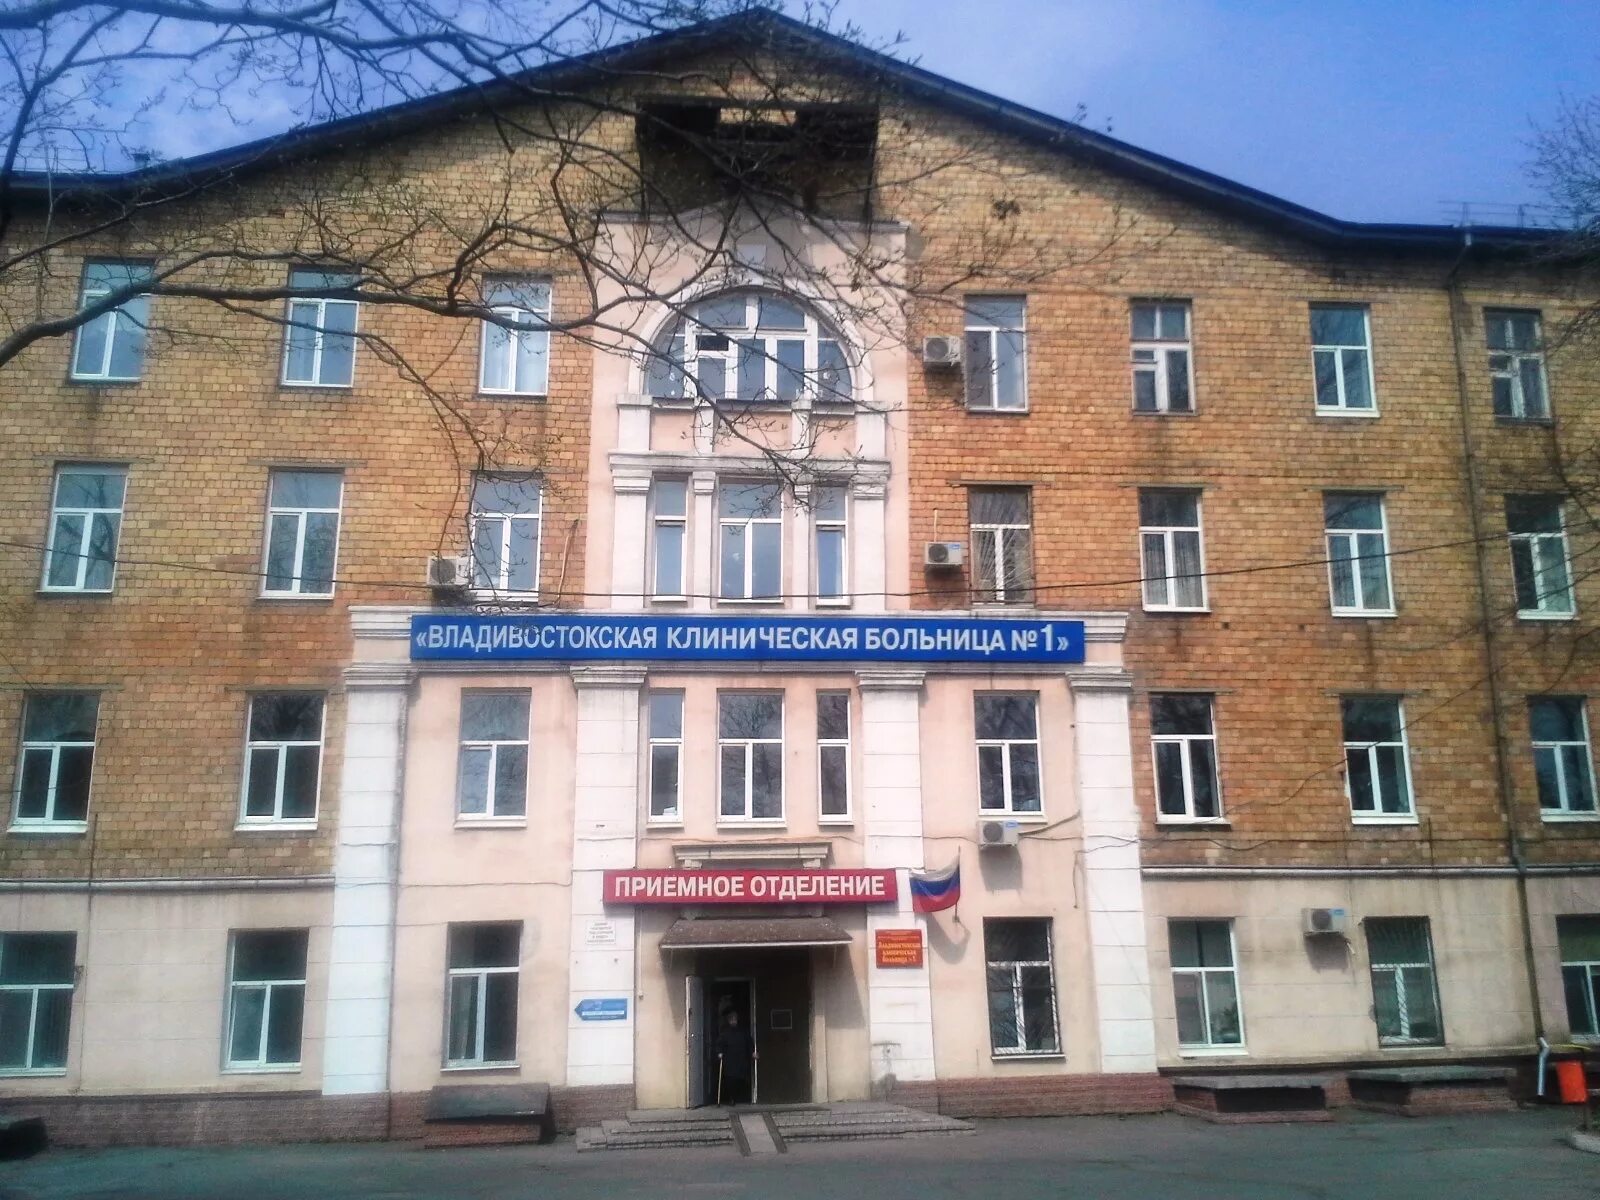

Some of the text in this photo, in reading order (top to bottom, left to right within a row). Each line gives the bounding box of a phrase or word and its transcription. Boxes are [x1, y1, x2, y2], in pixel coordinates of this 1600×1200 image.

[416, 624, 657, 652] «ВЛАДИВОСТОКСКАЯ
[667, 626, 858, 650] КЛИНИЧЕСКАЯ
[865, 627, 1006, 654] БОЛЬНИЦА
[615, 875, 885, 900] ПРИЕМНОЕ ОТДЕЛЕНИЕ
